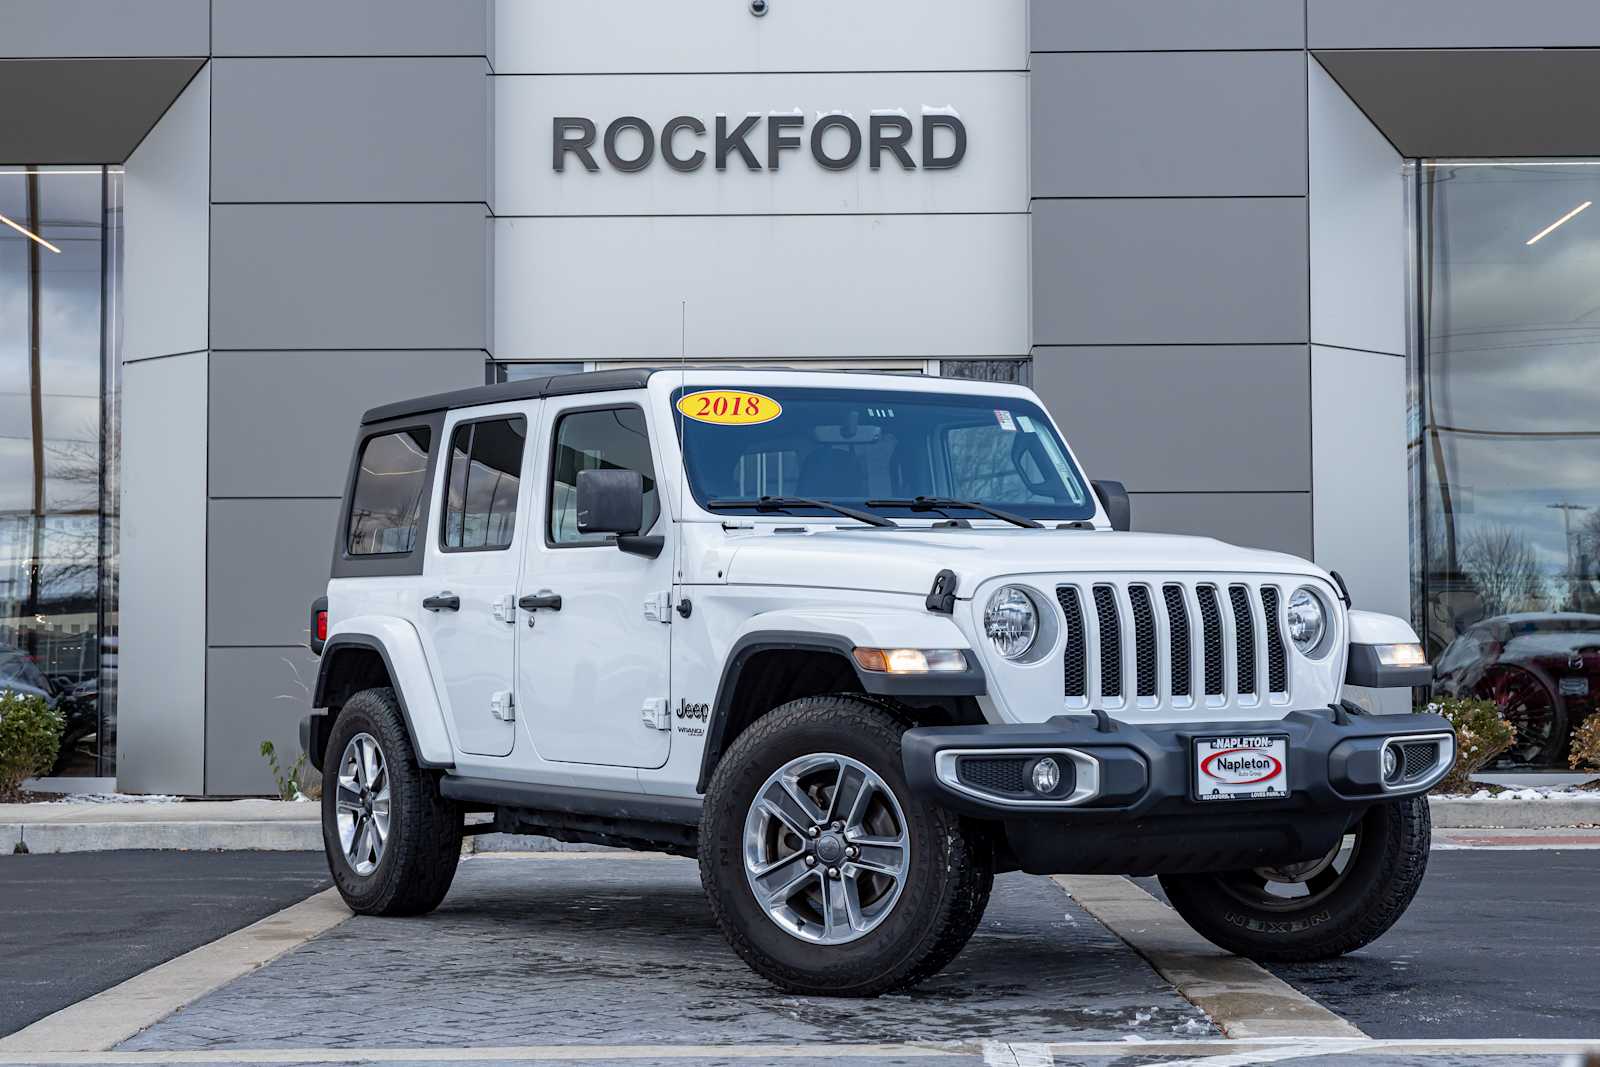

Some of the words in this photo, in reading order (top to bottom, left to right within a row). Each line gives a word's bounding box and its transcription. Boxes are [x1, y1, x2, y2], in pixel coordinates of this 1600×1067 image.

[553, 115, 967, 172] ROCKFORD
[696, 396, 760, 416] 2018
[676, 698, 709, 723] Jeep
[1216, 737, 1269, 748] NAPLETON
[1217, 757, 1270, 772] Napleton
[1223, 911, 1331, 934] NEXEN
